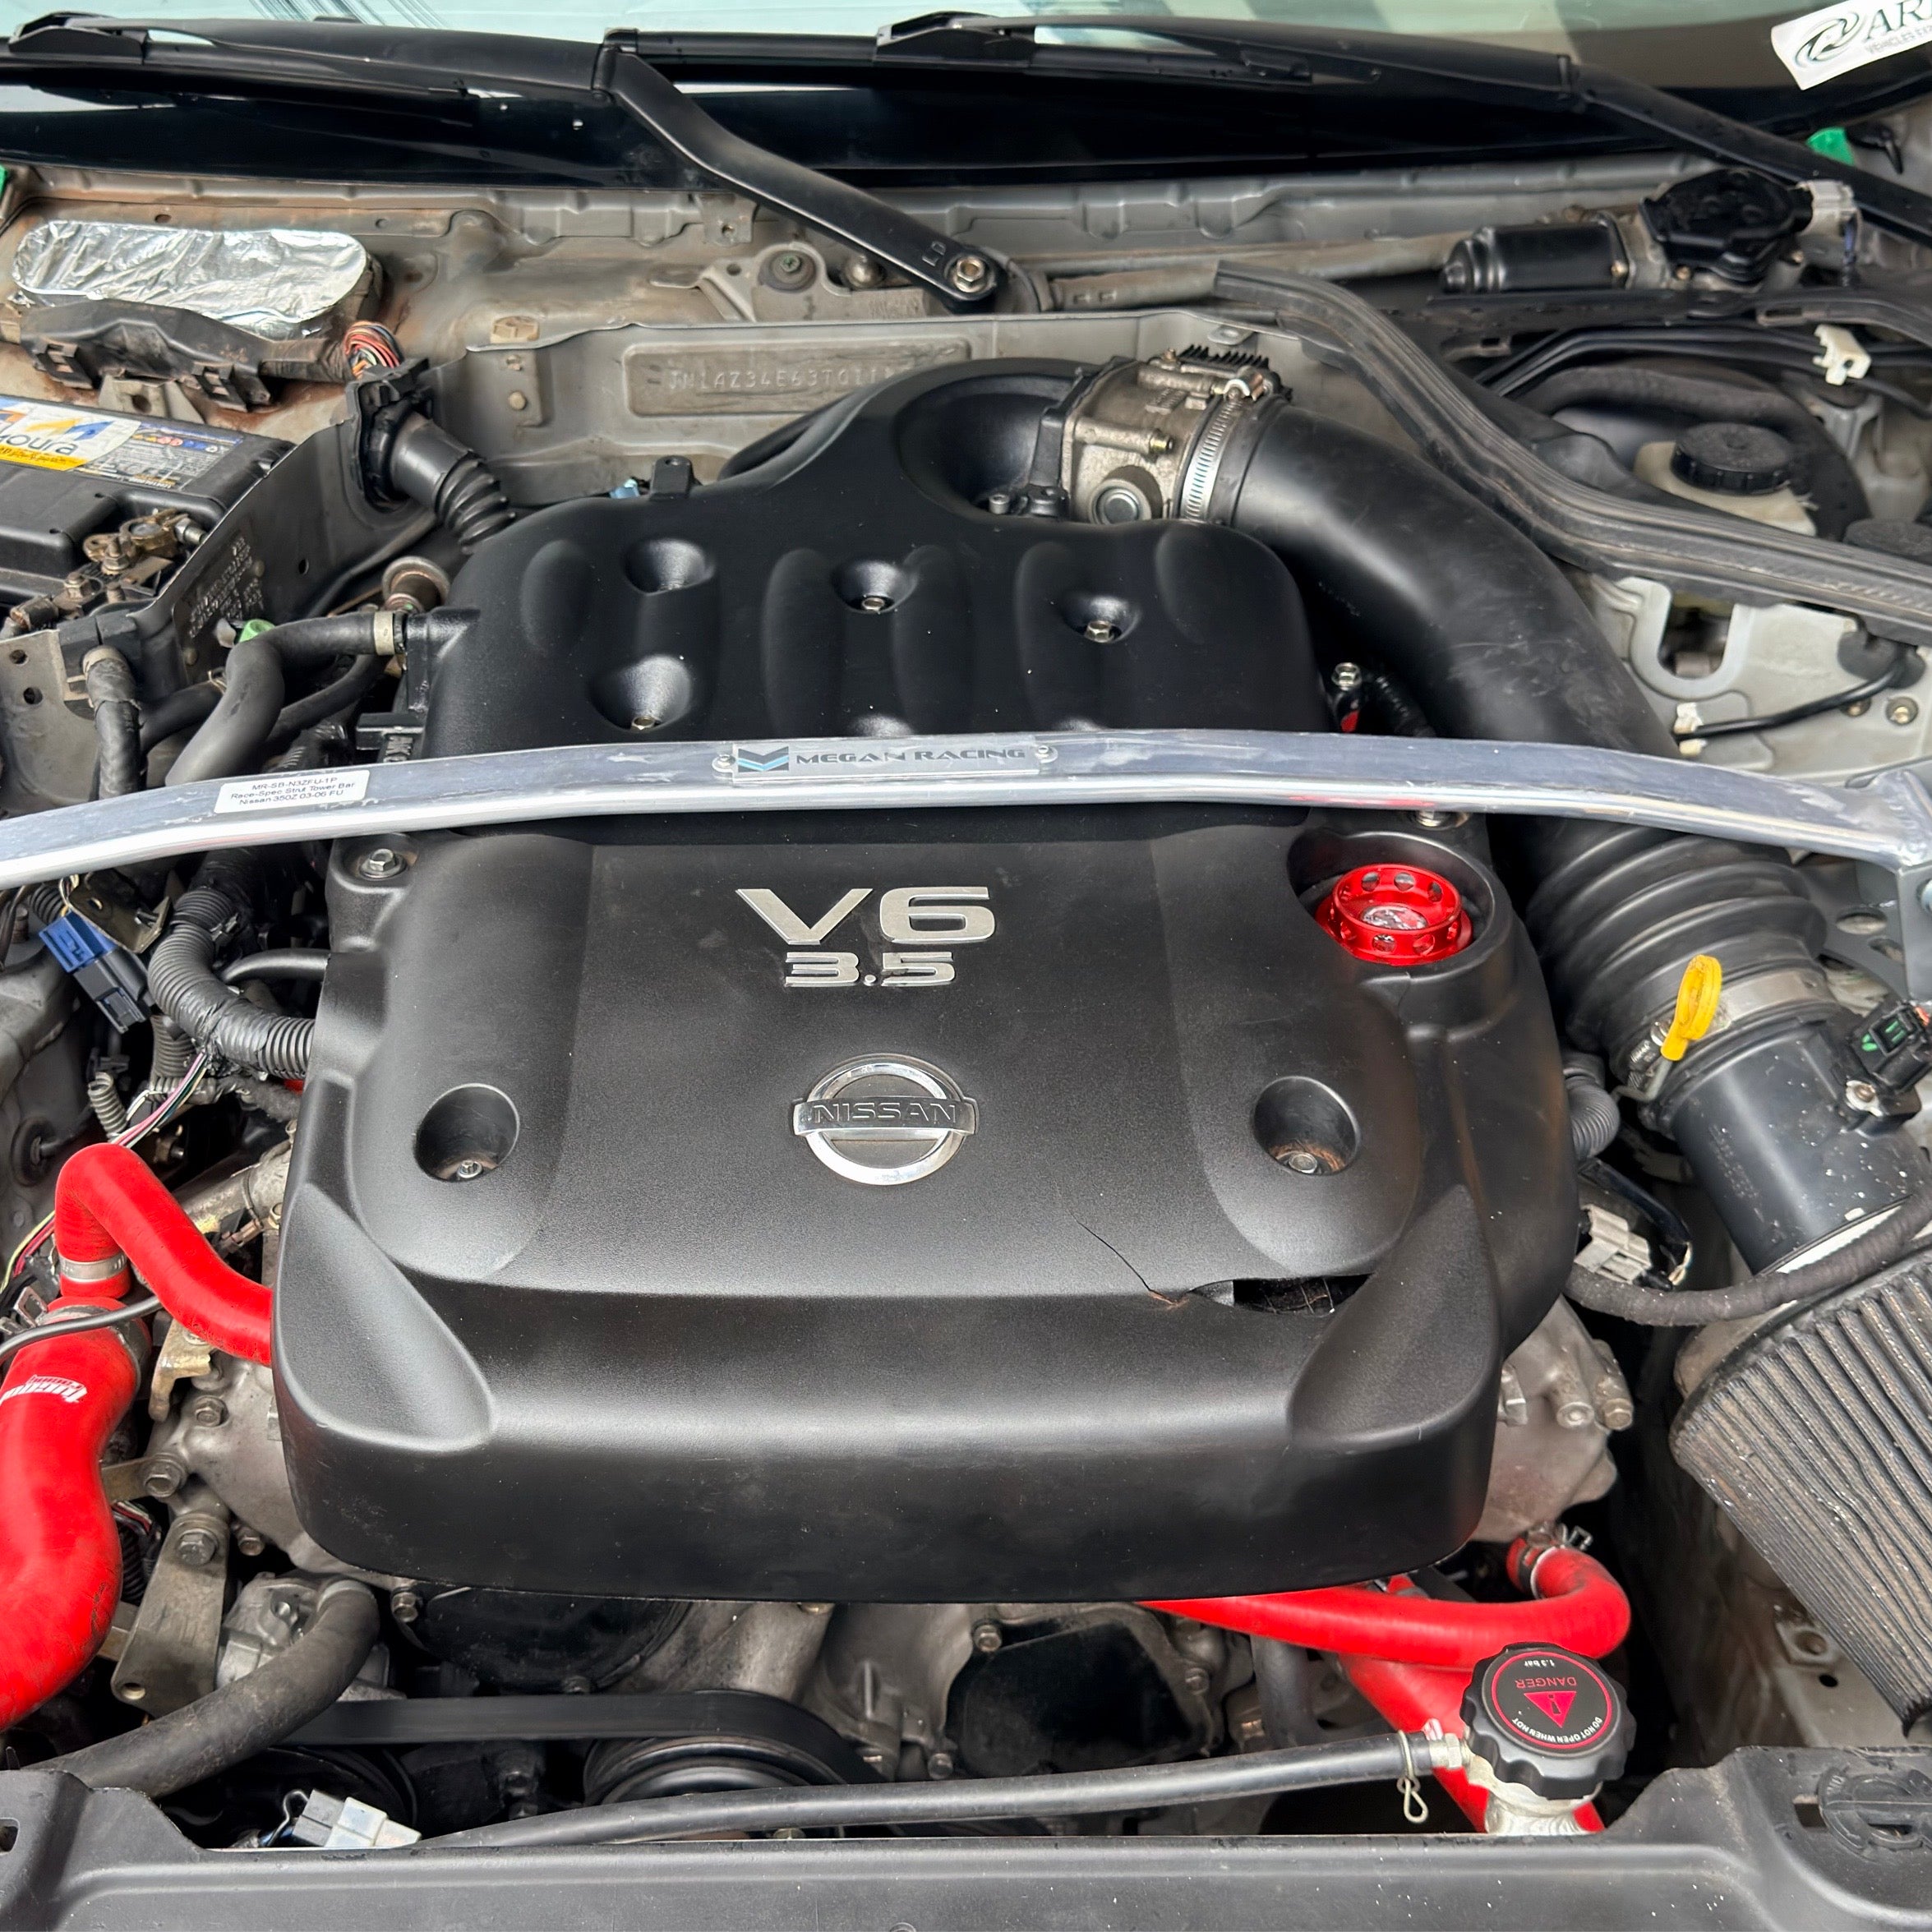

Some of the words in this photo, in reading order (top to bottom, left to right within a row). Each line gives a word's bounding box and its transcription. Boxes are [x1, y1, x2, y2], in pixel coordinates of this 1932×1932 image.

[1861, 0, 1932, 43] AR
[0, 434, 78, 455] oura
[795, 751, 906, 765] MEGAN
[914, 748, 1026, 762] RACING
[231, 788, 283, 800] Race-Spec
[285, 786, 307, 795] Strut
[310, 784, 335, 792] Tower
[338, 782, 356, 790] Bar
[239, 796, 272, 805] Nissan
[273, 794, 298, 802] 350Z
[299, 791, 327, 800] 03-06
[735, 886, 996, 946] V6
[785, 952, 956, 987] 3.5
[813, 1101, 957, 1124] NISSAN
[1524, 1659, 1541, 1668] bar
[1515, 1676, 1578, 1690] DANGER
[1592, 1716, 1603, 1728] DO
[1529, 1728, 1556, 1743] WHEN
[1556, 1733, 1581, 1743] OPEN
[1579, 1725, 1596, 1739] NOT
